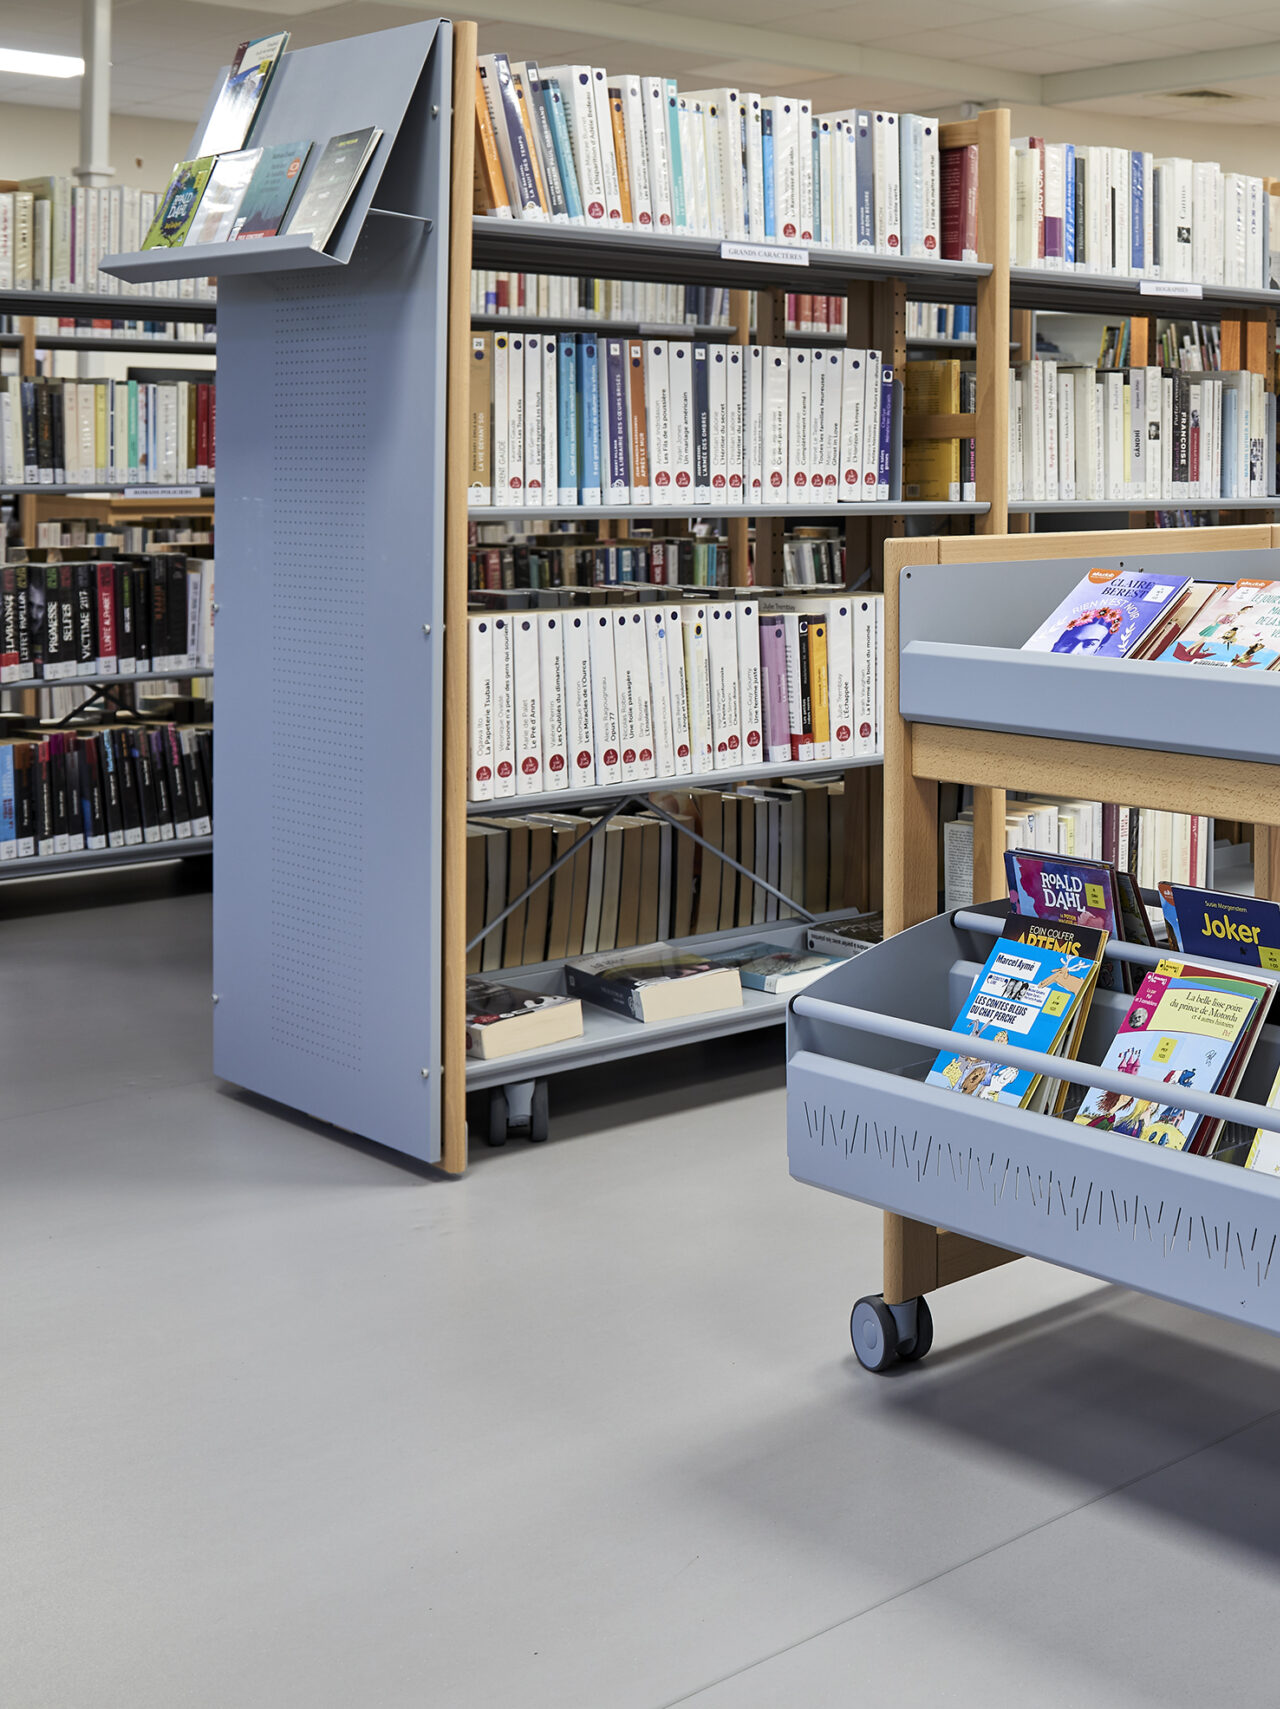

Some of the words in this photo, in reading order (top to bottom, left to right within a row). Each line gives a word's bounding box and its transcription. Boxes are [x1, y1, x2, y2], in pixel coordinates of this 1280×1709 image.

[518, 136, 527, 158] TEMPS
[522, 158, 530, 172] DES
[590, 147, 600, 185] Disparition
[525, 173, 533, 188] NUIT
[528, 189, 536, 198] LA
[596, 186, 602, 195] La
[728, 248, 756, 256] GRANDS
[684, 454, 689, 465] Un
[618, 468, 624, 476] LA
[1101, 586, 1149, 598] BEREST
[1110, 578, 1155, 589] CLAIRE
[1257, 594, 1280, 604] JOUR
[1072, 600, 1099, 614] RIEN
[1125, 601, 1140, 620] NOIR
[48, 601, 58, 653] PROMESSE
[62, 604, 73, 642] SELFIES
[80, 612, 92, 660] VICTIME
[626, 670, 634, 706] passagère
[555, 693, 562, 702] du
[582, 697, 590, 730] Miracles
[610, 712, 616, 722] 77
[484, 709, 492, 745] Papeterie
[610, 722, 618, 742] Opus
[556, 734, 564, 747] Les
[485, 746, 491, 756] La
[1040, 872, 1083, 892] ROALD
[1042, 888, 1087, 912] DAHL
[1204, 900, 1217, 910] Susie
[1030, 925, 1048, 936] EOIN
[1046, 928, 1075, 941] COLFER
[1202, 912, 1261, 945] Joker
[1017, 932, 1082, 957] ARTEMIS
[996, 954, 1018, 968] Marcel
[1017, 960, 1036, 972] Aymé
[970, 1004, 980, 1015] DU
[979, 1007, 994, 1018] CHAT
[974, 994, 988, 1006] LES
[986, 997, 1010, 1012] CONTES
[1008, 1002, 1028, 1016] BLEUS
[1169, 998, 1179, 1008] du
[1178, 1002, 1200, 1014] prince
[1199, 1006, 1209, 1016] de
[1208, 1008, 1238, 1022] Motordu
[1186, 991, 1196, 1001] La
[1195, 994, 1212, 1006] belle
[1211, 998, 1227, 1008] lisse
[1225, 1003, 1243, 1014] poire
[1214, 1018, 1235, 1028] histoires
